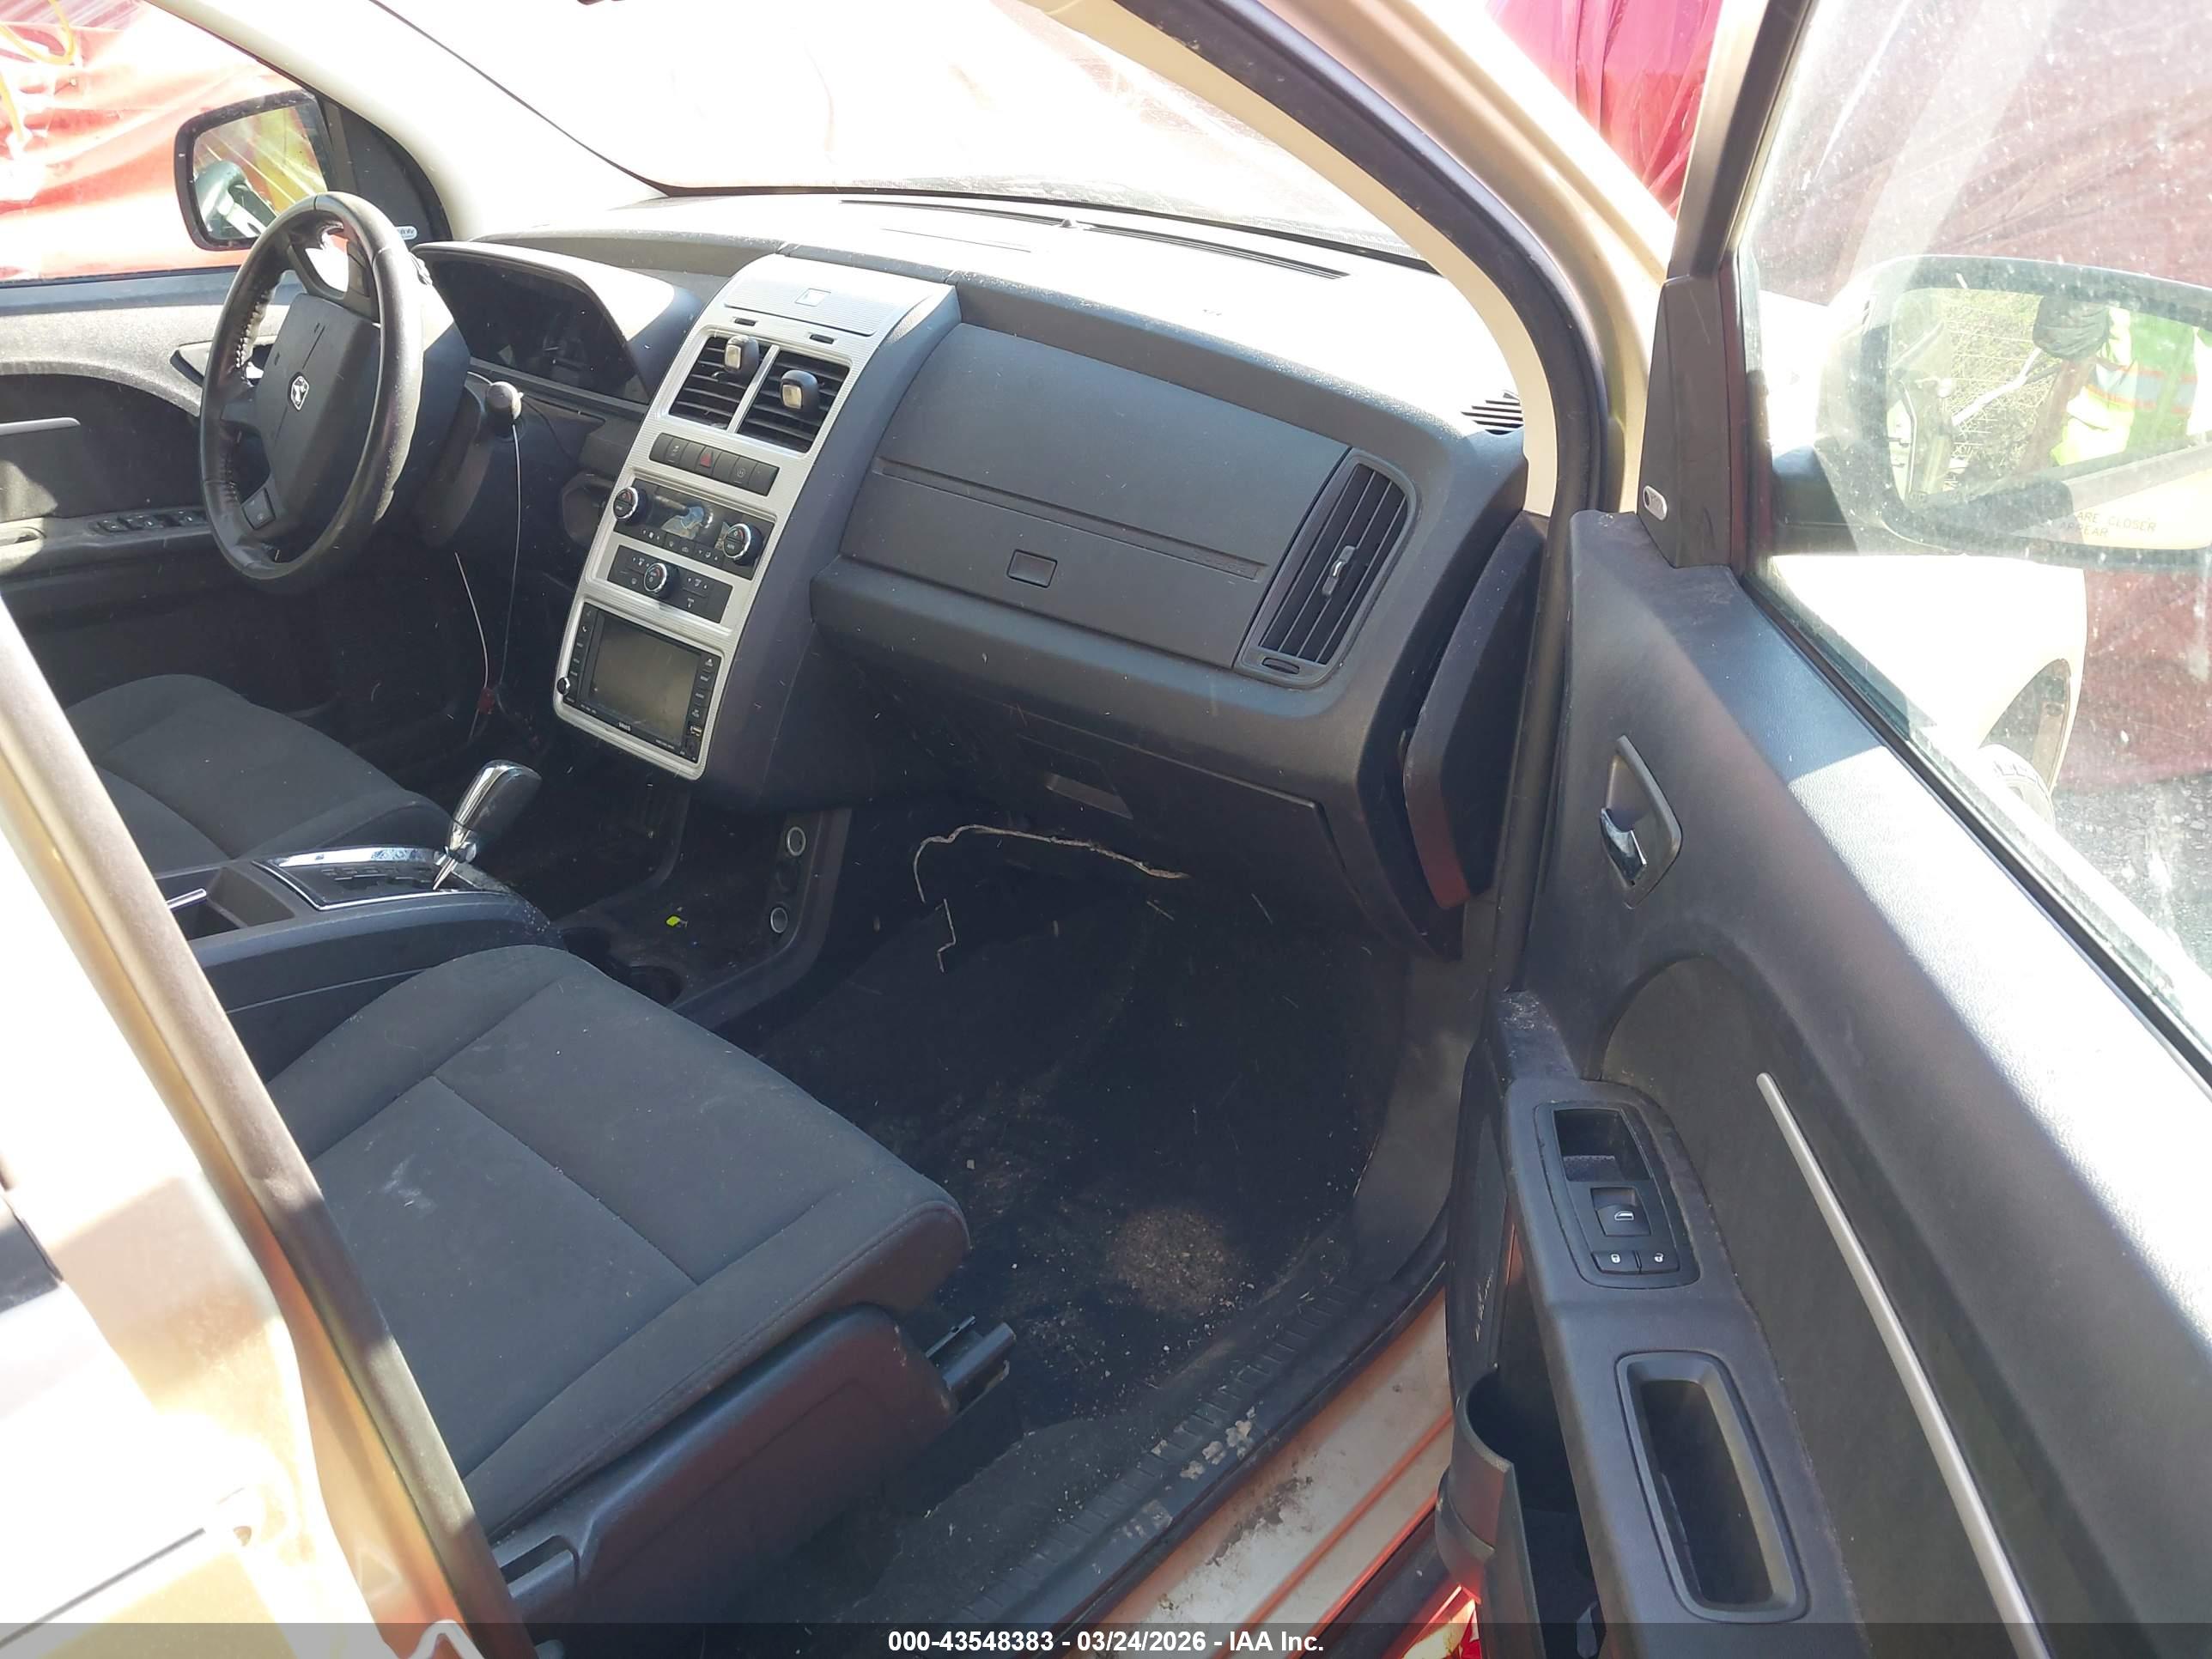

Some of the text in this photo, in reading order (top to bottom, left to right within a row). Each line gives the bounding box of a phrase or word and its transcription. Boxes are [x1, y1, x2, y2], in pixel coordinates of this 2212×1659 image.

[2059, 521, 2109, 537] APPEAR
[2077, 512, 2156, 532] ARE CLOSER
